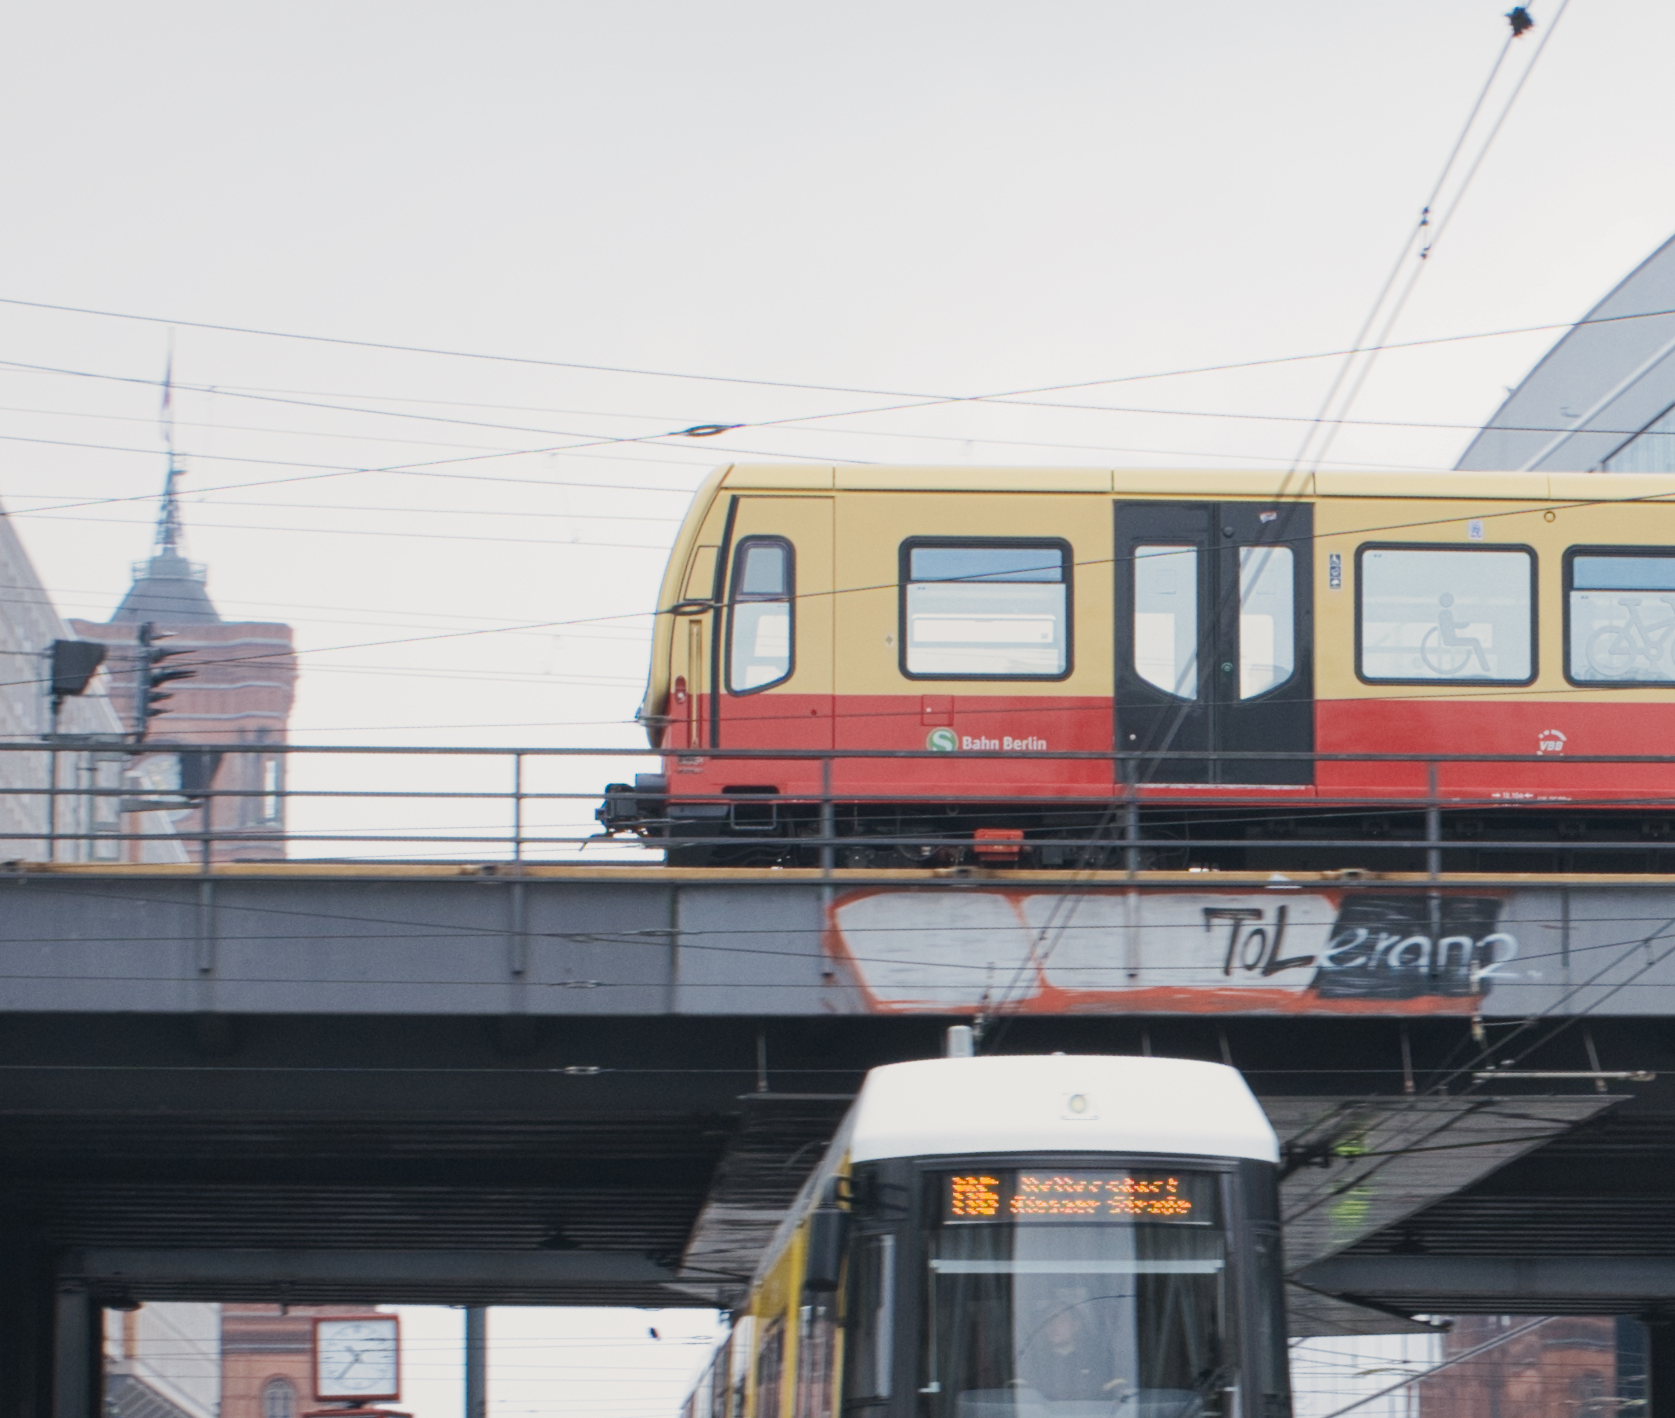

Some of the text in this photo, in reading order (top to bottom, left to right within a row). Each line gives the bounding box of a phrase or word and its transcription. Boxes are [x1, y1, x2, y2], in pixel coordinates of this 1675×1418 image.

[962, 735, 1000, 750] Bahn
[1003, 735, 1047, 751] Berlin
[1540, 740, 1564, 751] VBB
